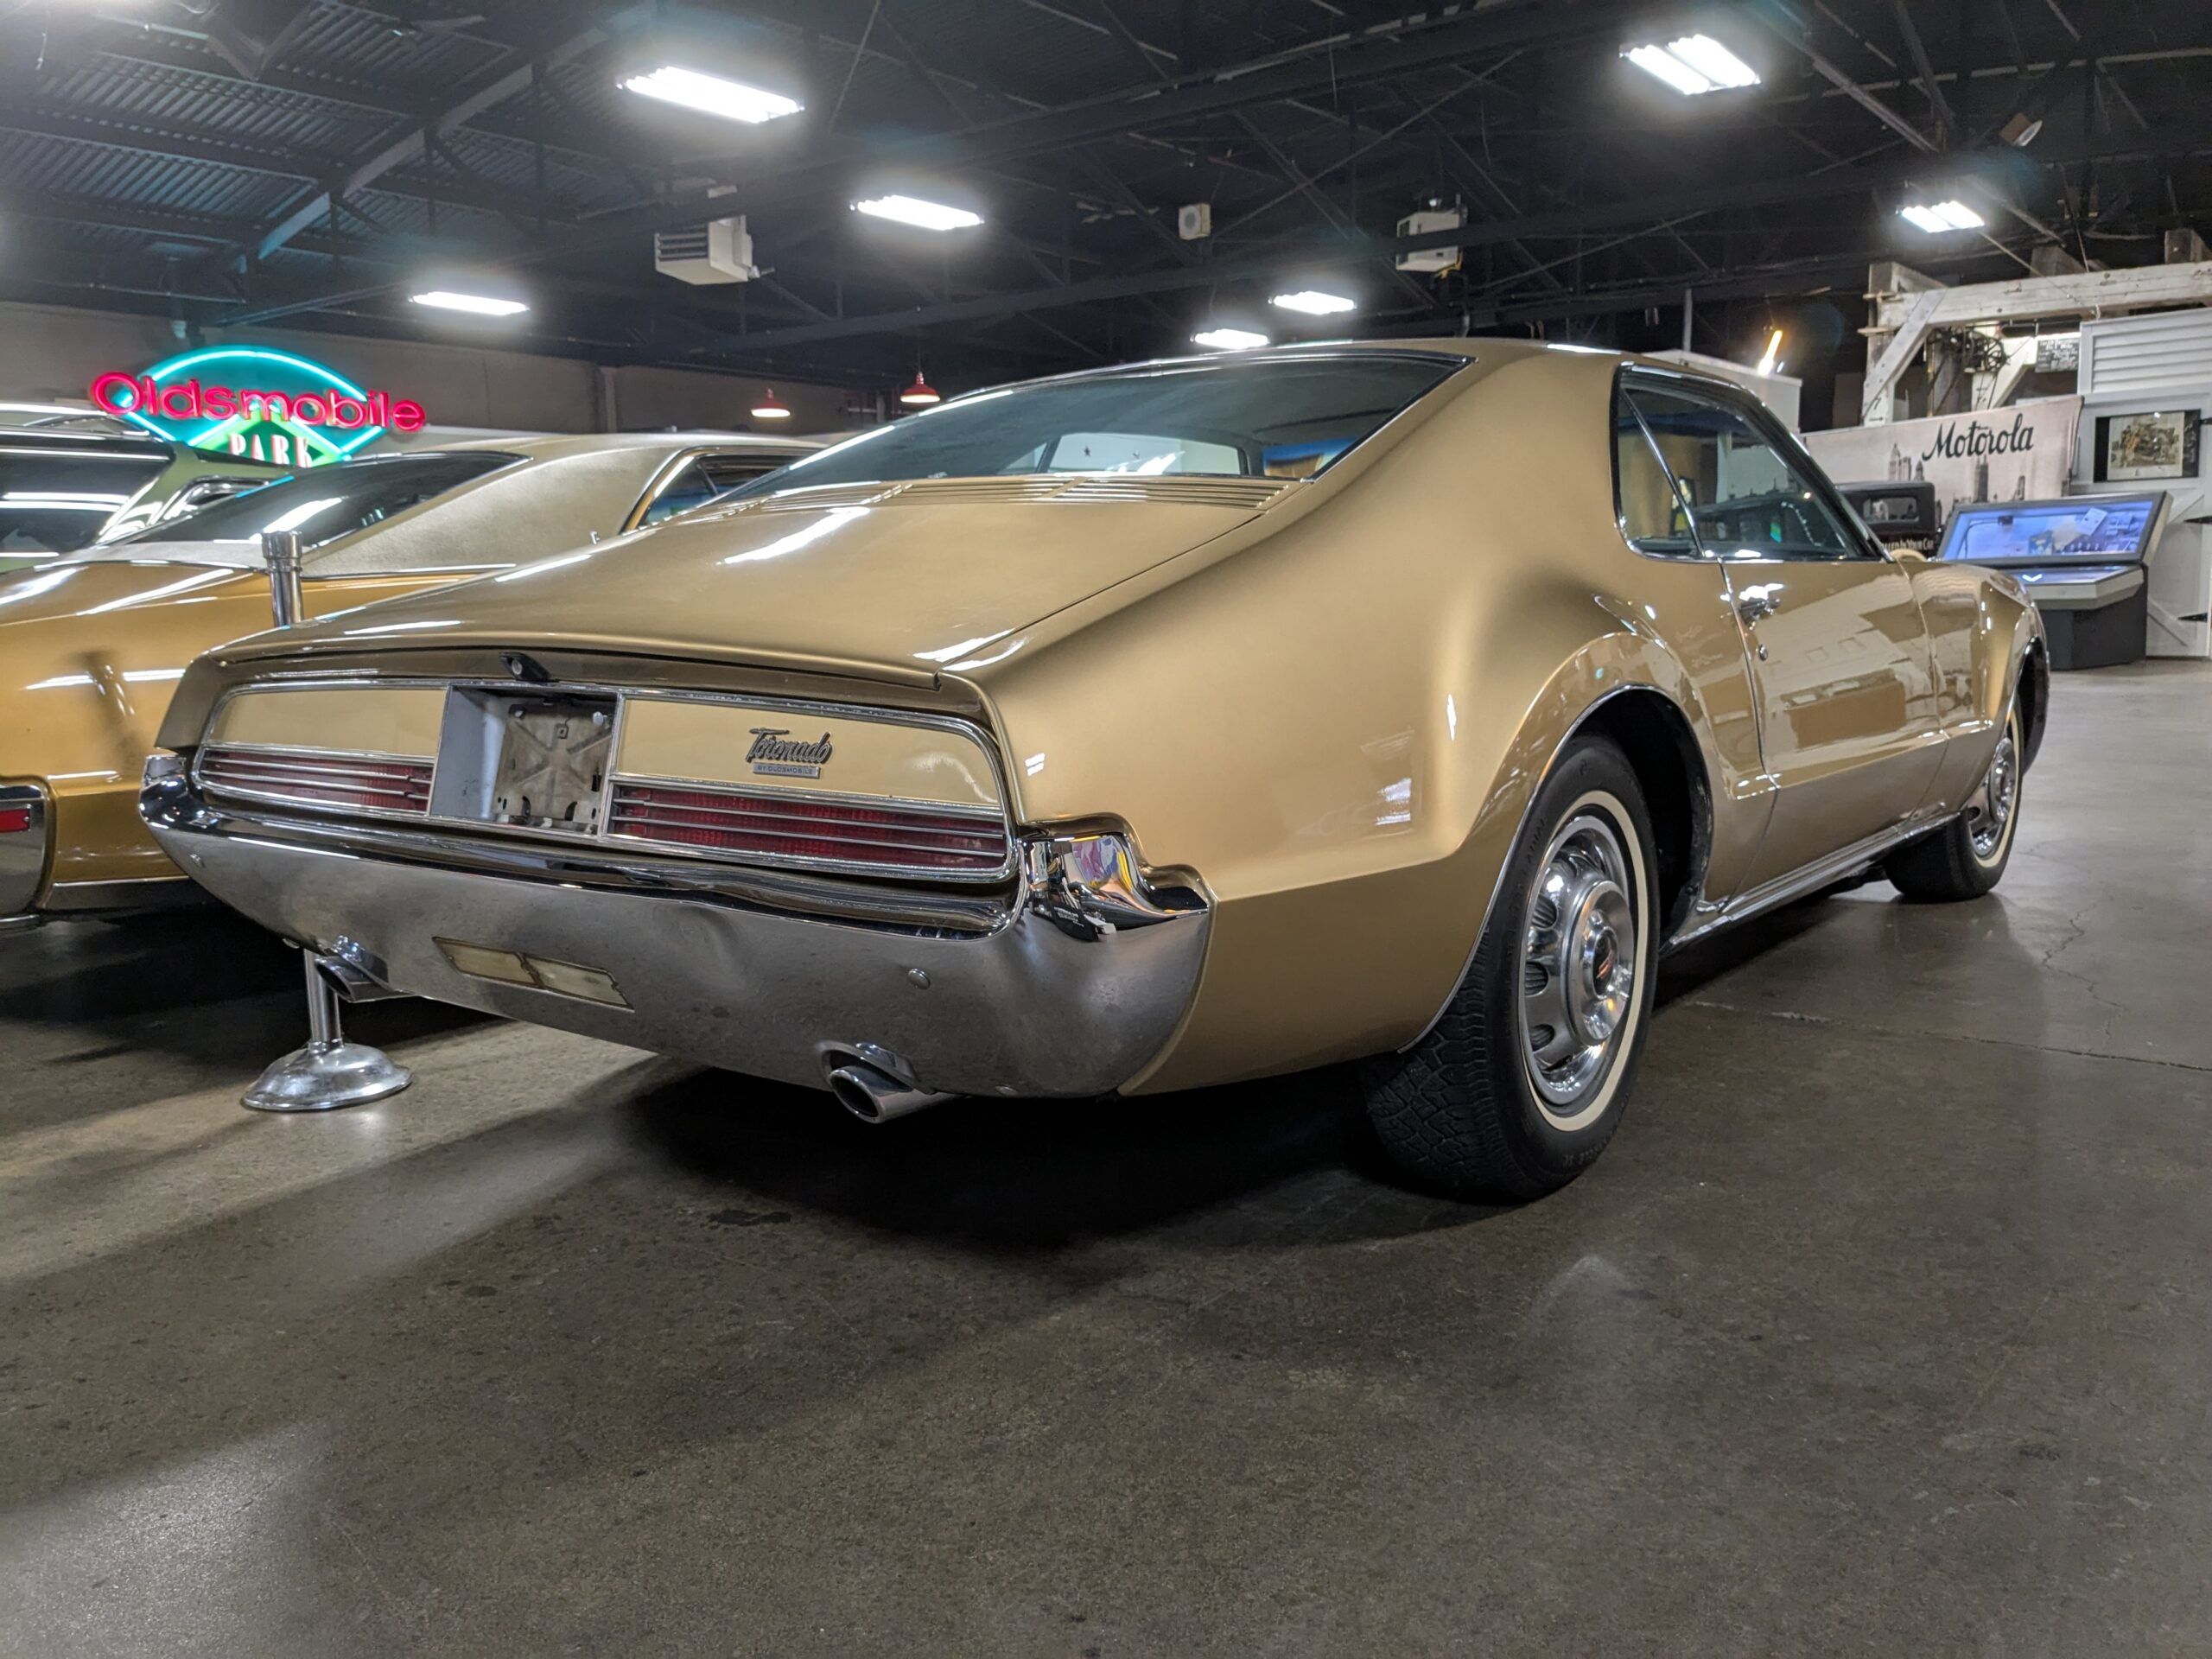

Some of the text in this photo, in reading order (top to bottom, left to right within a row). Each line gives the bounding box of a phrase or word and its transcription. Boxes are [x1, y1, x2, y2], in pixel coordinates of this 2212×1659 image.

[91, 372, 426, 431] Oldsmobile
[228, 434, 313, 468] PARK
[1922, 413, 2034, 461] Motorola
[746, 728, 833, 764] Toronado
[768, 766, 813, 775] OLDSMOBILE
